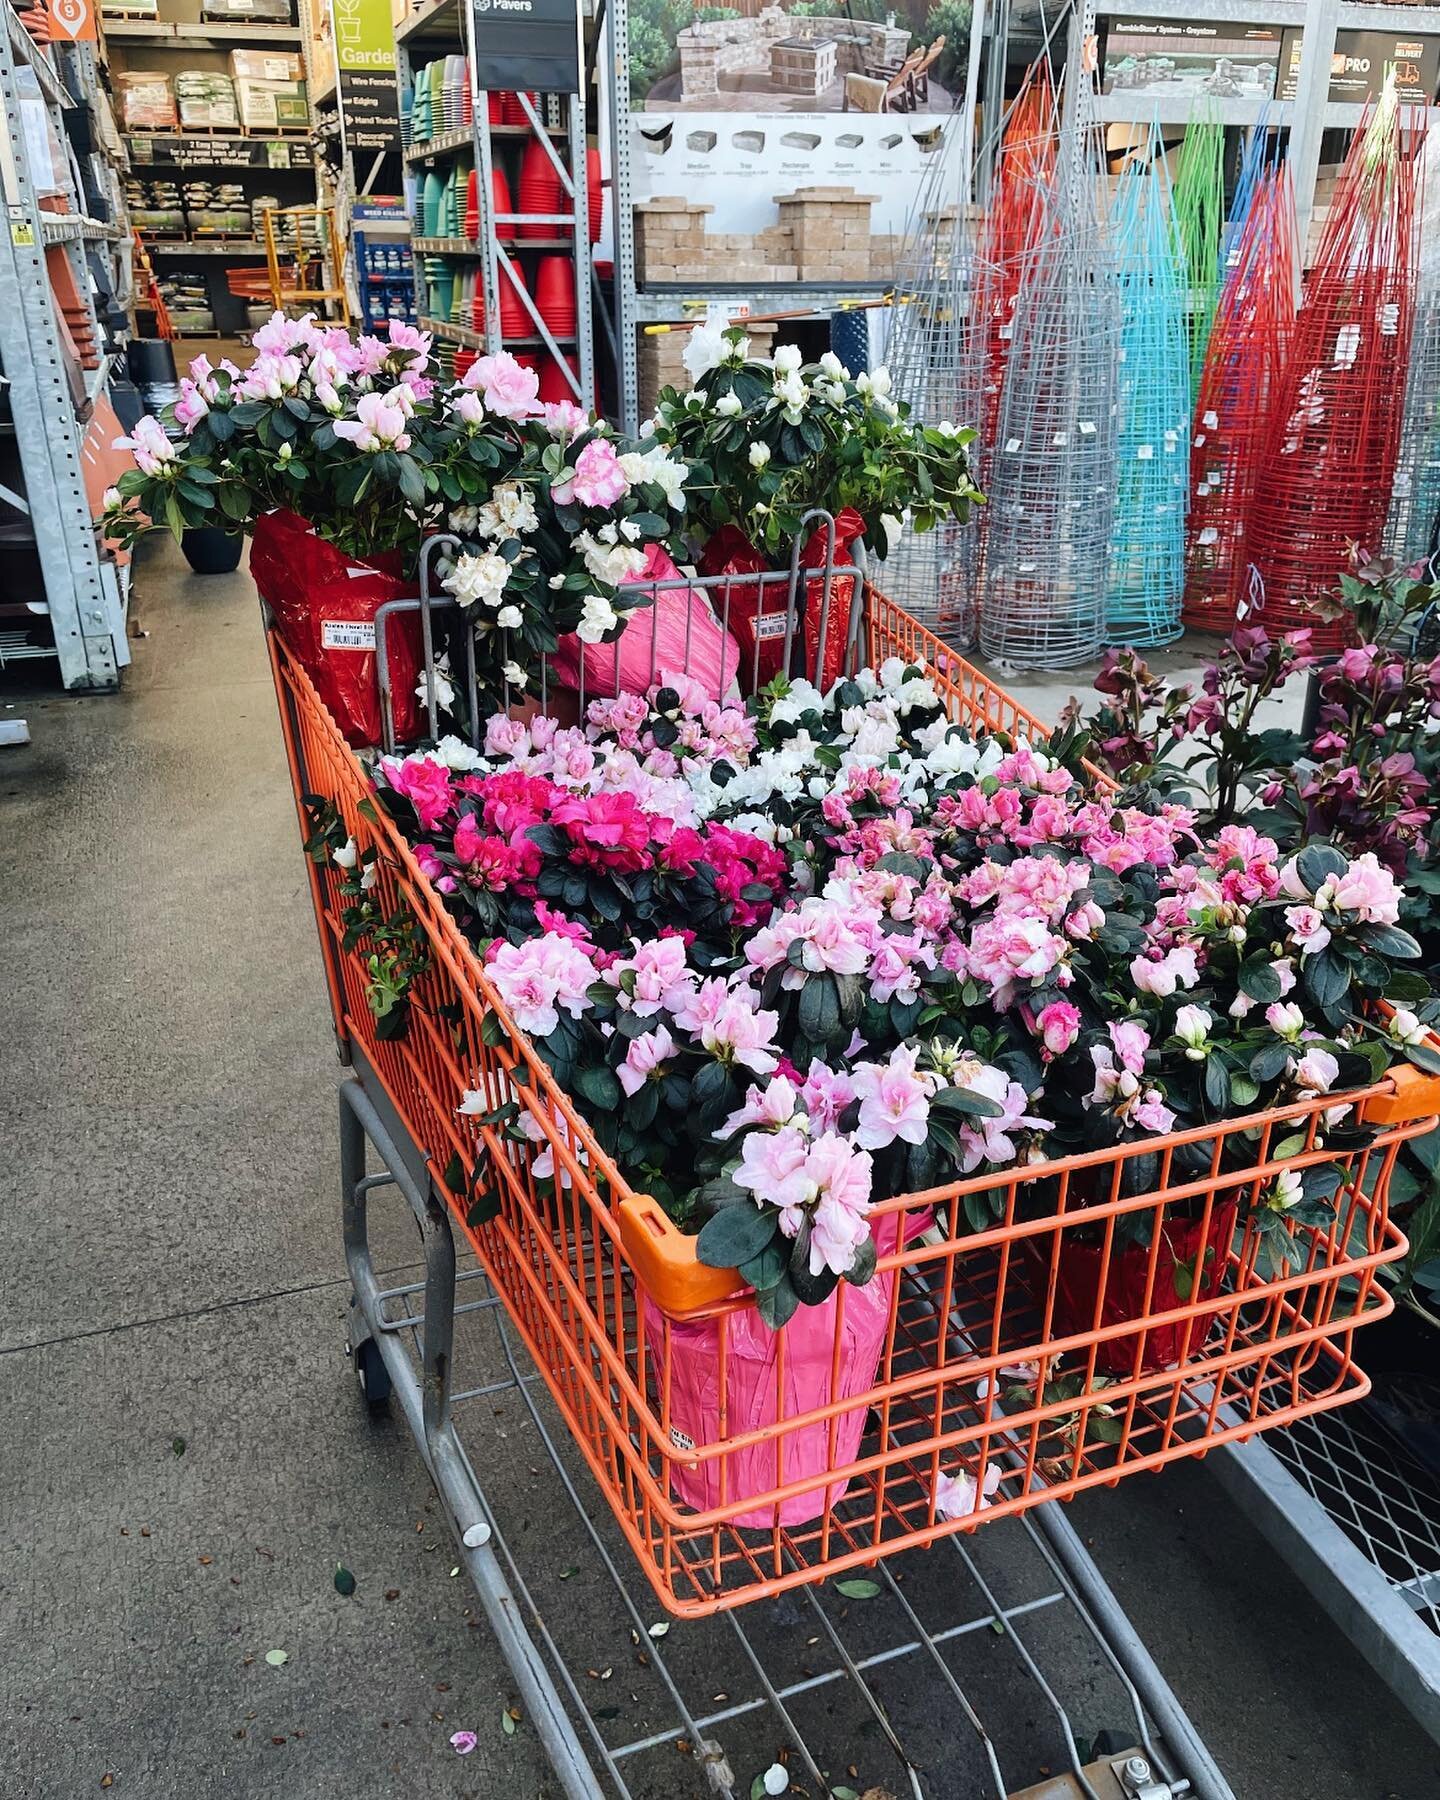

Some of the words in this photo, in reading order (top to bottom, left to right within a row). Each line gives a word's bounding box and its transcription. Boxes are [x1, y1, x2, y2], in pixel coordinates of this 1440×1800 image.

[493, 0, 532, 11] Pavers
[1345, 57, 1371, 73] PRO
[351, 77, 368, 86] Wire
[353, 96, 378, 107] Edging
[355, 116, 375, 124] Hand
[376, 117, 398, 125] Trucks
